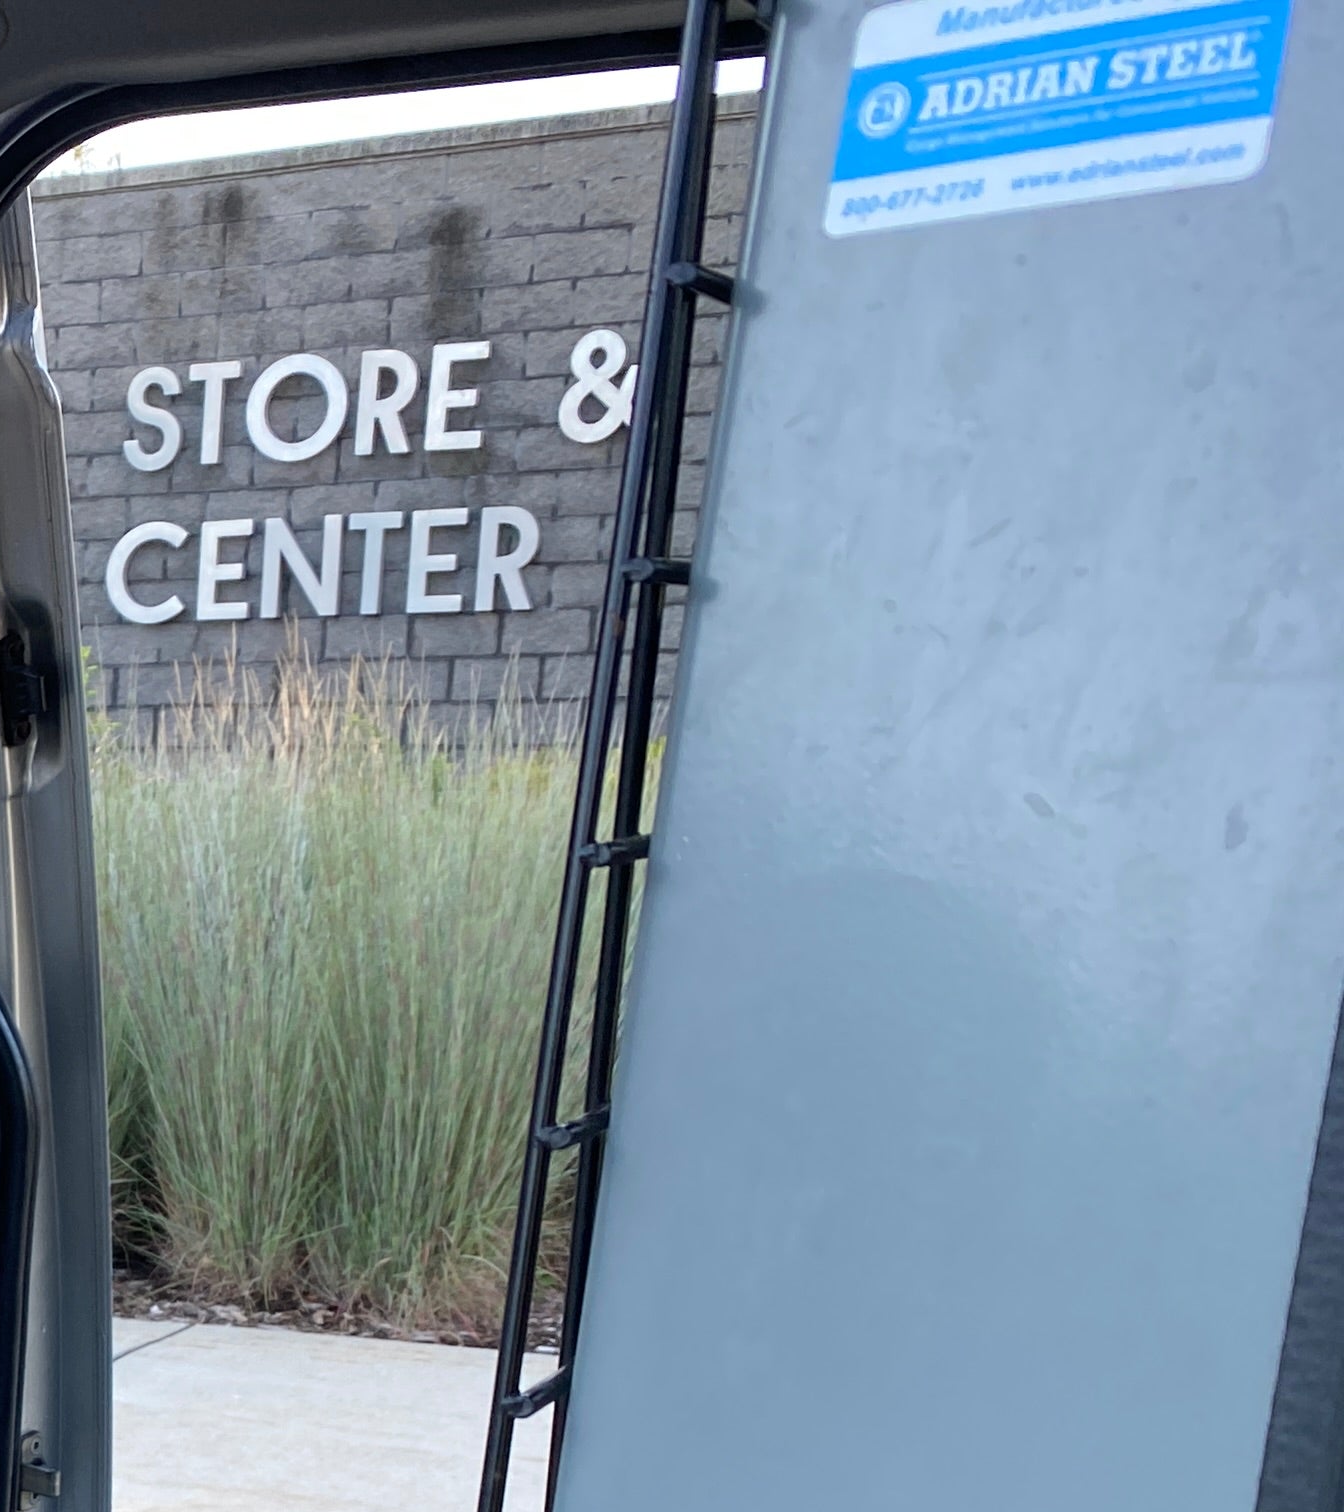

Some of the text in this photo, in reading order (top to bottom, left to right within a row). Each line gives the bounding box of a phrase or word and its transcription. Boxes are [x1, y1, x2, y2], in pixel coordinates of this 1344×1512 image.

[936, 0, 1146, 36] Manufac
[916, 57, 1098, 122] ADRIAN
[1107, 32, 1256, 90] STEEL
[123, 329, 639, 472] STORE &
[105, 505, 541, 625] CENTER
